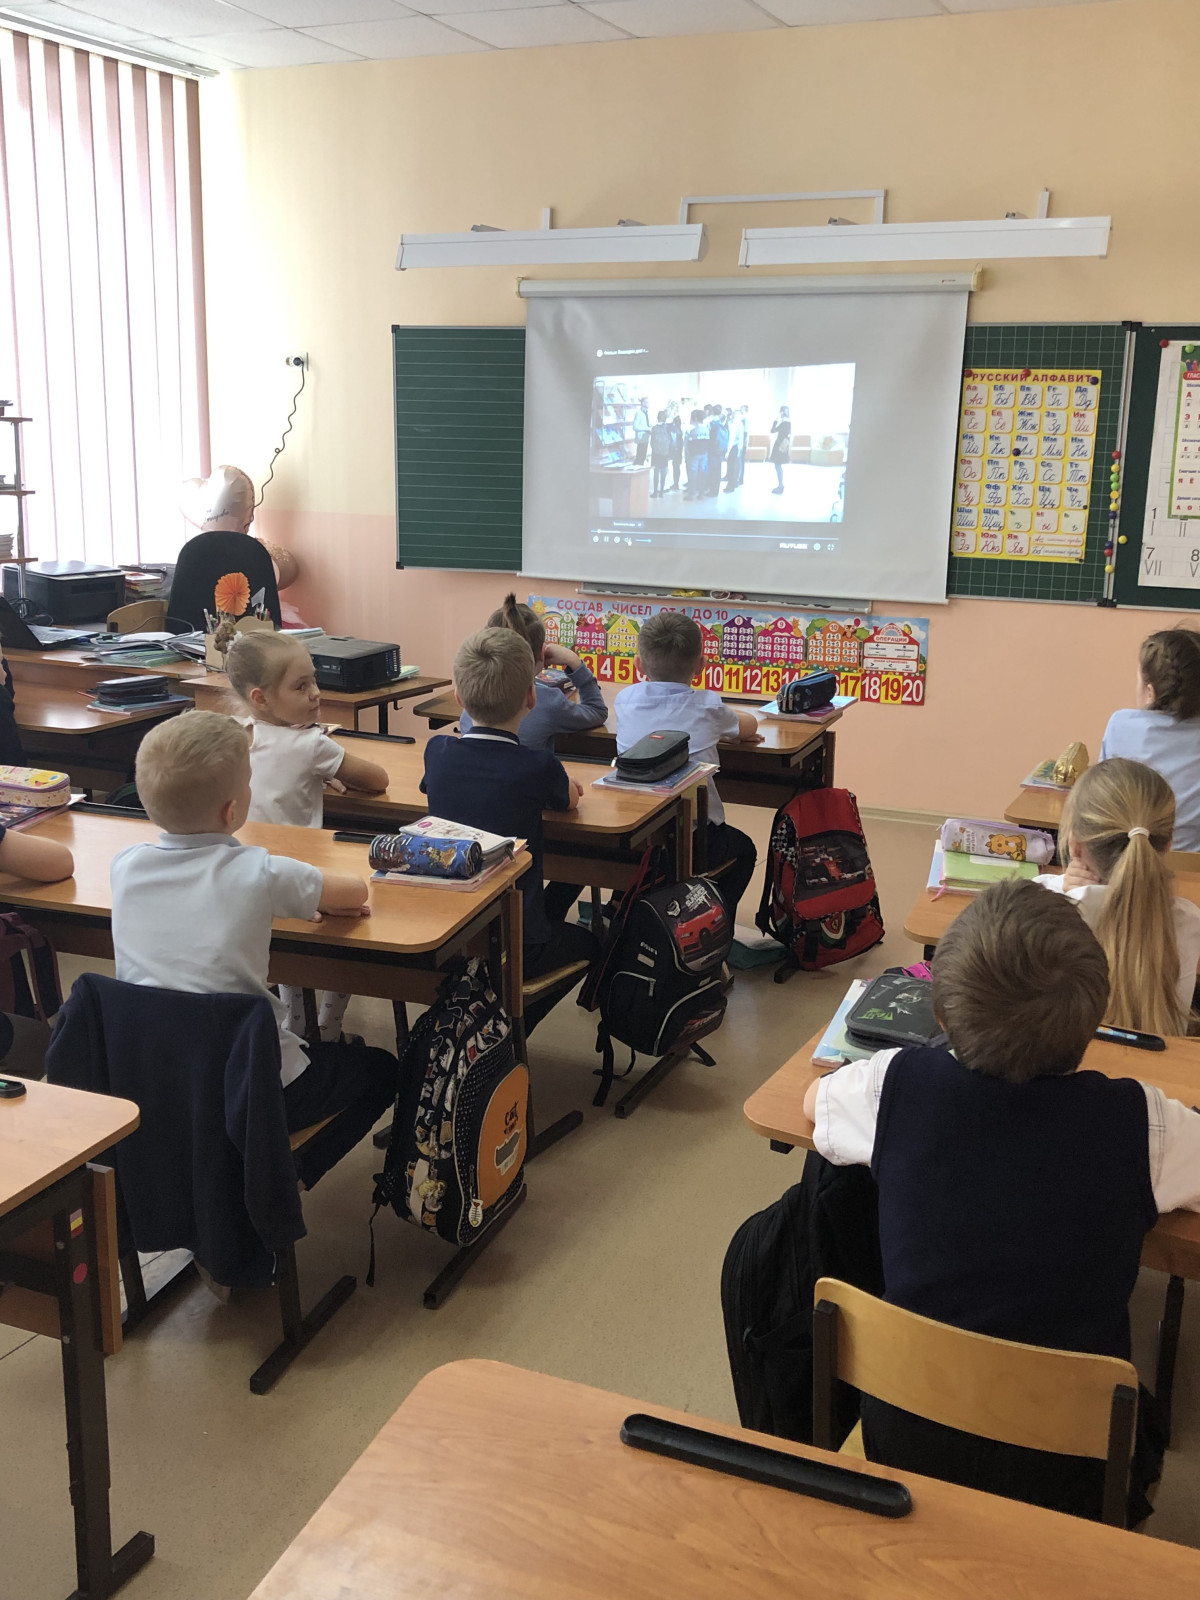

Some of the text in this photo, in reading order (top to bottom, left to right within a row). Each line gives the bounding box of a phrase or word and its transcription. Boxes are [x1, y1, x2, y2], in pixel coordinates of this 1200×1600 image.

[972, 373, 1092, 382] РУССКИЙ АЛФАВИТ
[1152, 508, 1157, 519] 1
[1146, 547, 1200, 561] 7 8
[1145, 560, 1161, 576] VII
[557, 600, 603, 612] СОСТАВ
[612, 603, 652, 616] ЧИСЕЛ
[692, 608, 712, 620] ДО
[715, 610, 728, 620] 10
[600, 658, 612, 678] 4
[618, 659, 630, 680] 5
[706, 666, 723, 688] 10
[725, 667, 740, 690] 11
[744, 668, 761, 691] 12
[763, 670, 780, 692] 13
[841, 675, 861, 698] 17
[862, 677, 880, 699] 18
[882, 678, 901, 700] 19
[902, 680, 923, 702] 20
